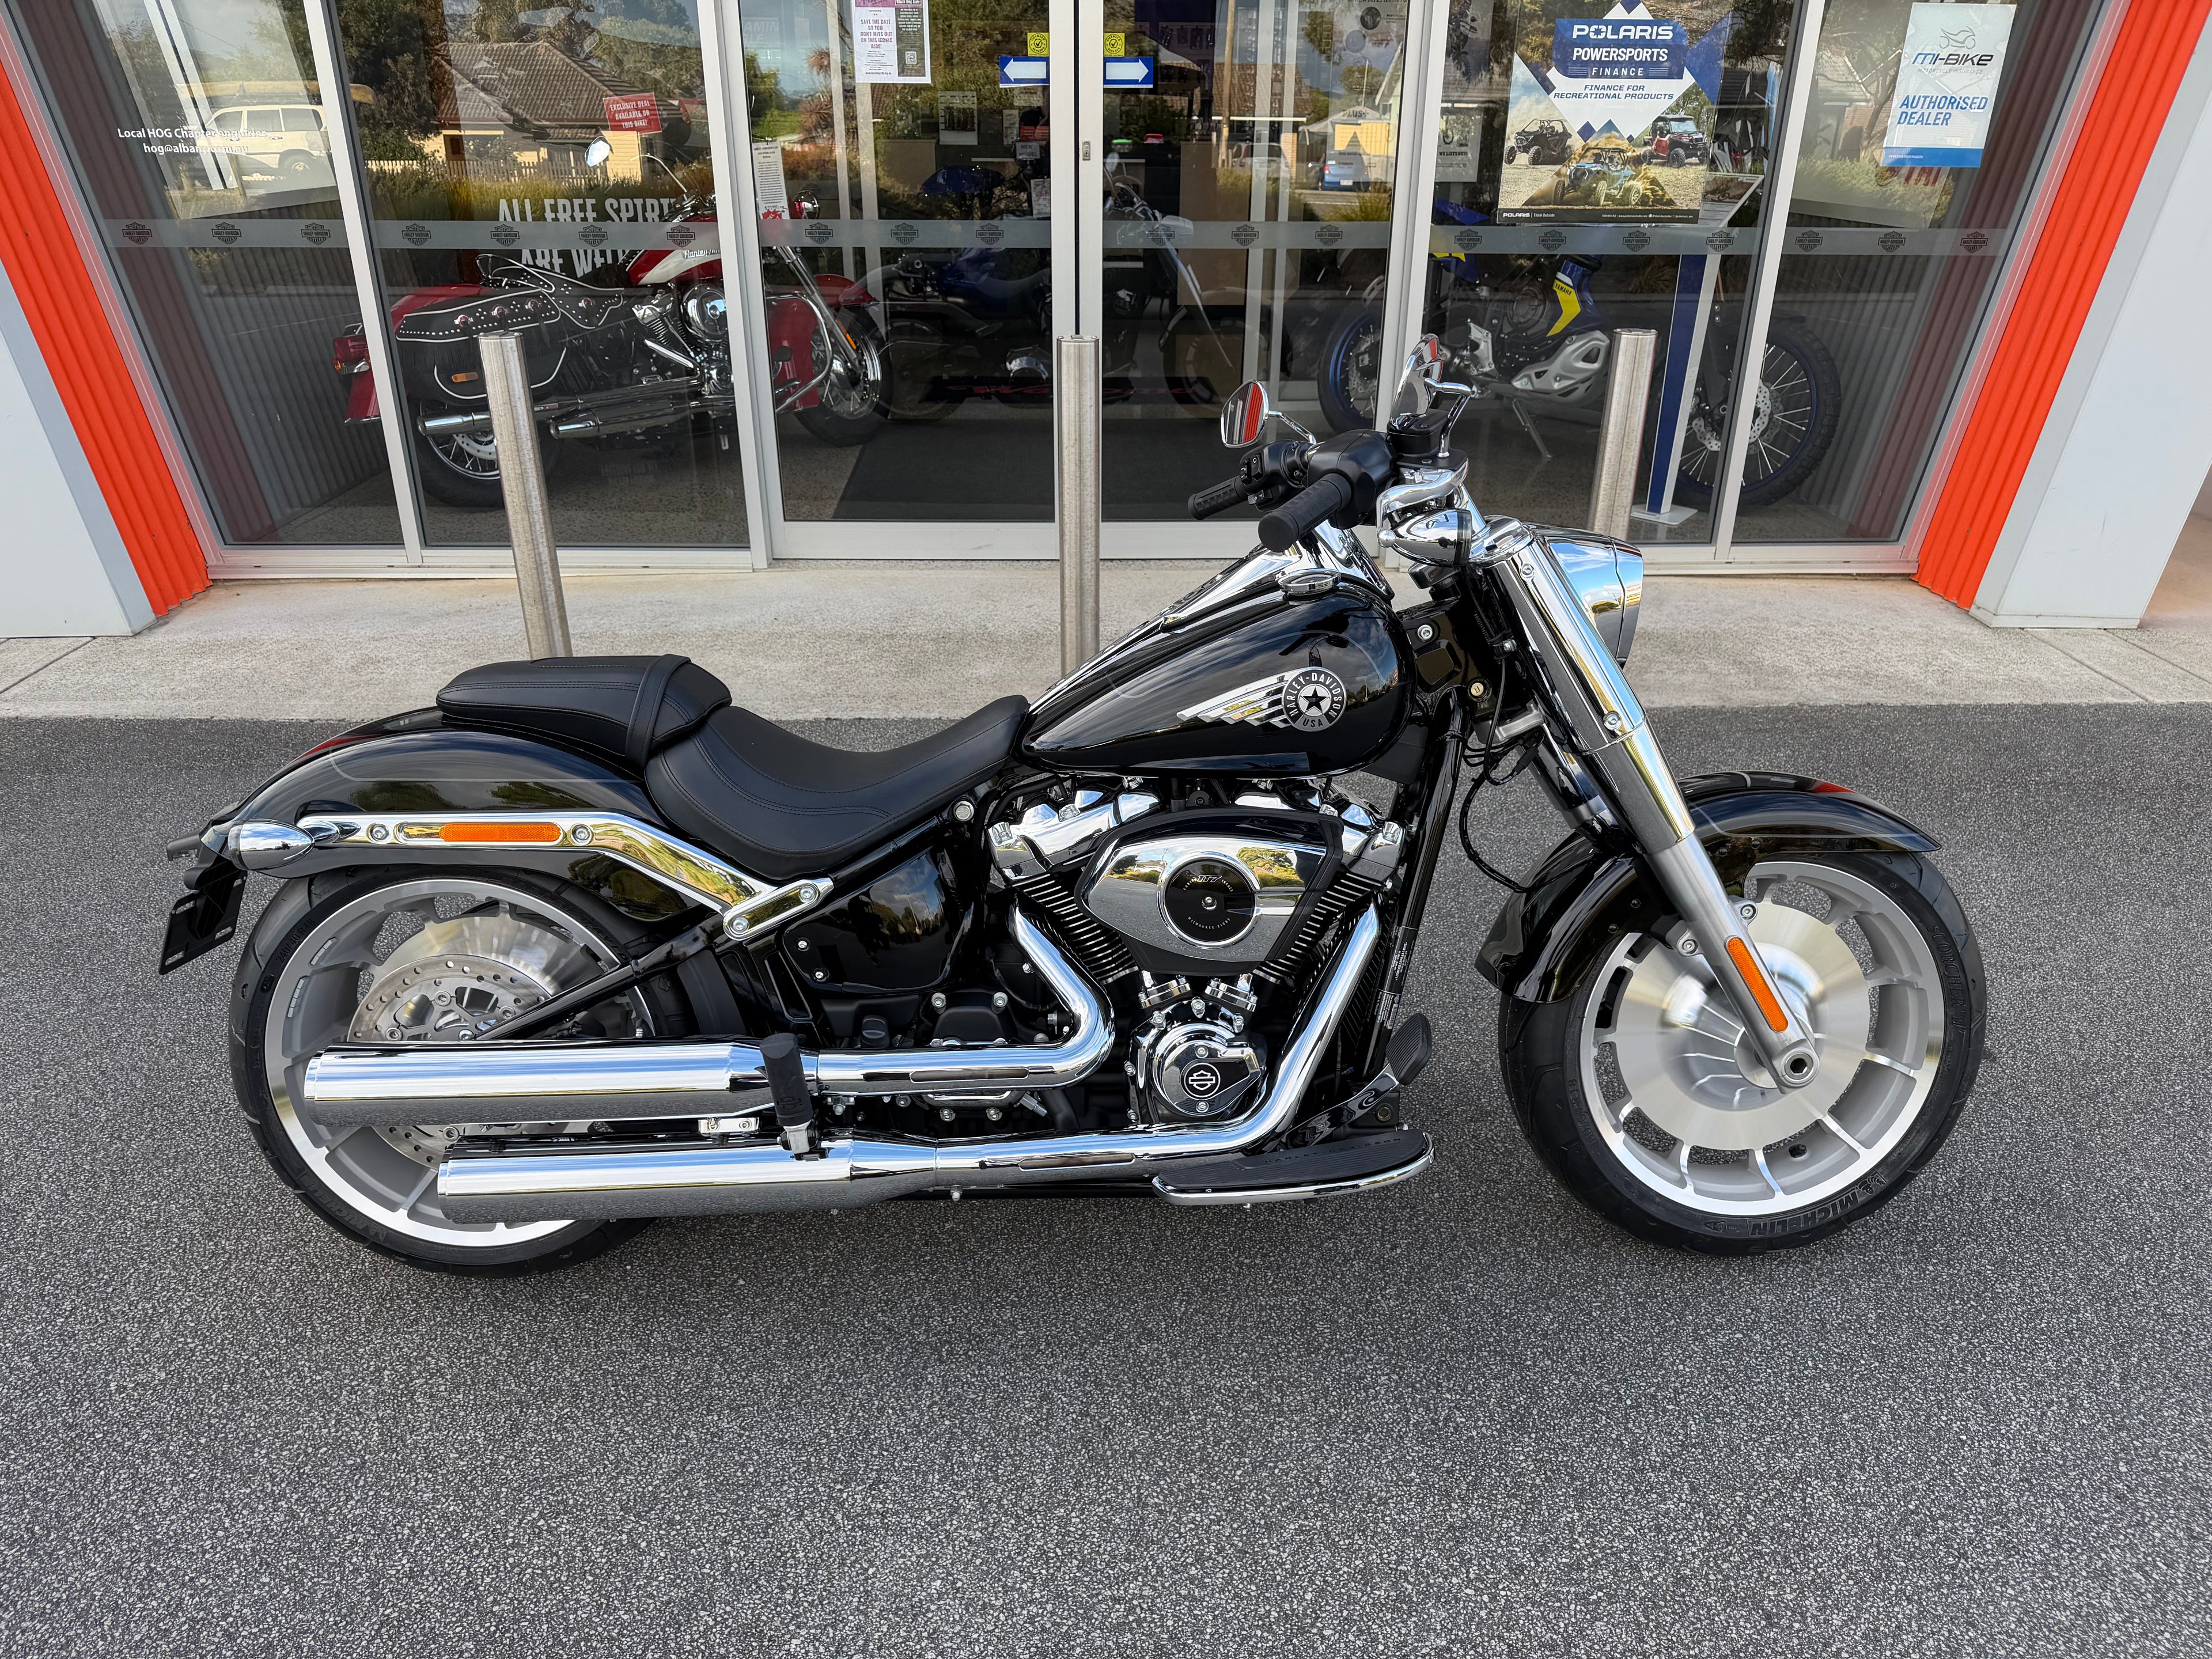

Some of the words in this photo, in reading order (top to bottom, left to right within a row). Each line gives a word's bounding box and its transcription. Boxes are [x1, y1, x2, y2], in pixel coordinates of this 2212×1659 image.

[1572, 25, 1673, 40] POLARIS
[1572, 47, 1668, 62] POWERSPORTS
[1592, 67, 1644, 76] FINANCE
[610, 101, 637, 111] EXCLUSIVE
[638, 100, 650, 108] DEAL
[1899, 94, 1988, 111] AUTHORISED
[615, 111, 642, 120] AVAILABLE
[1897, 111, 1952, 126] DEALER
[622, 121, 634, 129] THIS
[117, 128, 146, 138] Local
[147, 128, 172, 138] HOG
[174, 128, 216, 140] Chapter
[1555, 283, 1572, 296] YAMAHA
[1286, 672, 1342, 718] HARLEY-DAVIDSON
[1302, 718, 1323, 728] USA
[1197, 874, 1222, 882] 117
[1221, 879, 1233, 892] INCHES
[276, 934, 300, 964] 240/40
[1927, 925, 1965, 1007] SCORCHER
[299, 1174, 368, 1230] MICHELIN
[1750, 1190, 1859, 1236] MICHELIN
